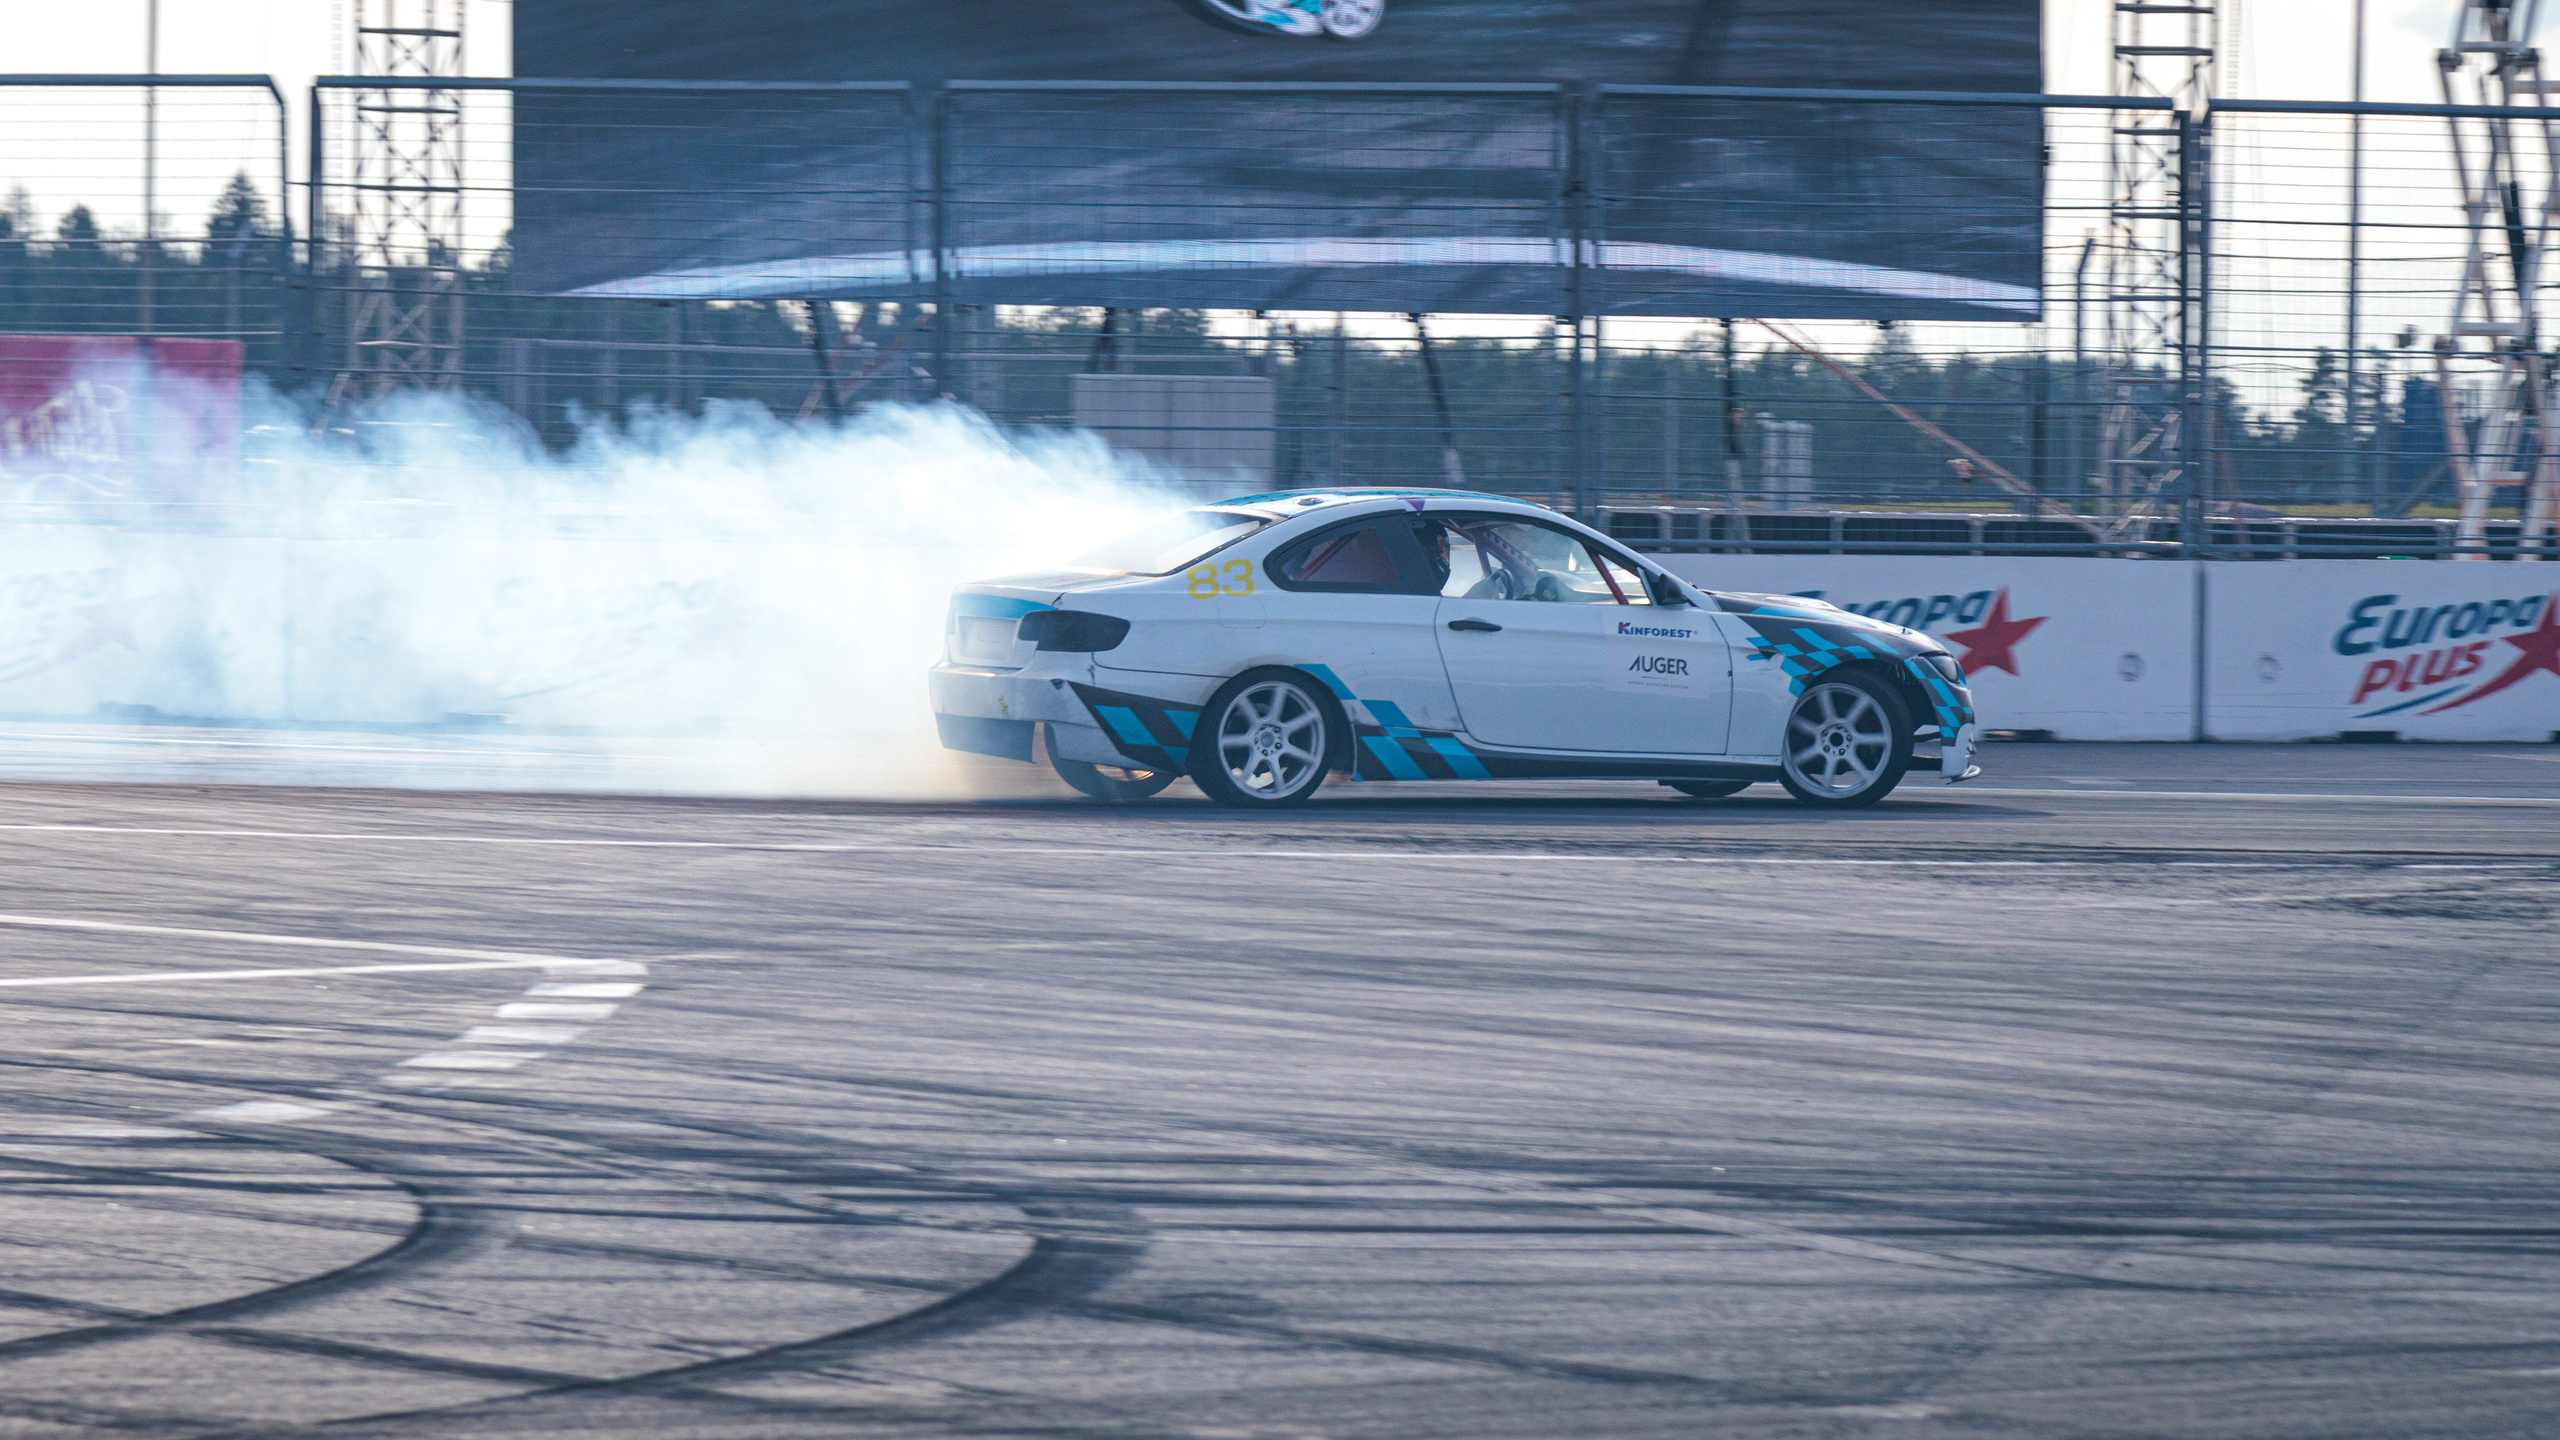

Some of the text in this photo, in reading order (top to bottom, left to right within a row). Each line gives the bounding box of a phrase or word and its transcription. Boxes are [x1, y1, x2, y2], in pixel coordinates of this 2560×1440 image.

[1186, 559, 1255, 599] 83
[1617, 621, 1693, 639] KINFOREST
[1787, 590, 1995, 630] ropa
[2332, 594, 2549, 656] Europa
[1628, 654, 1690, 676] AUGER
